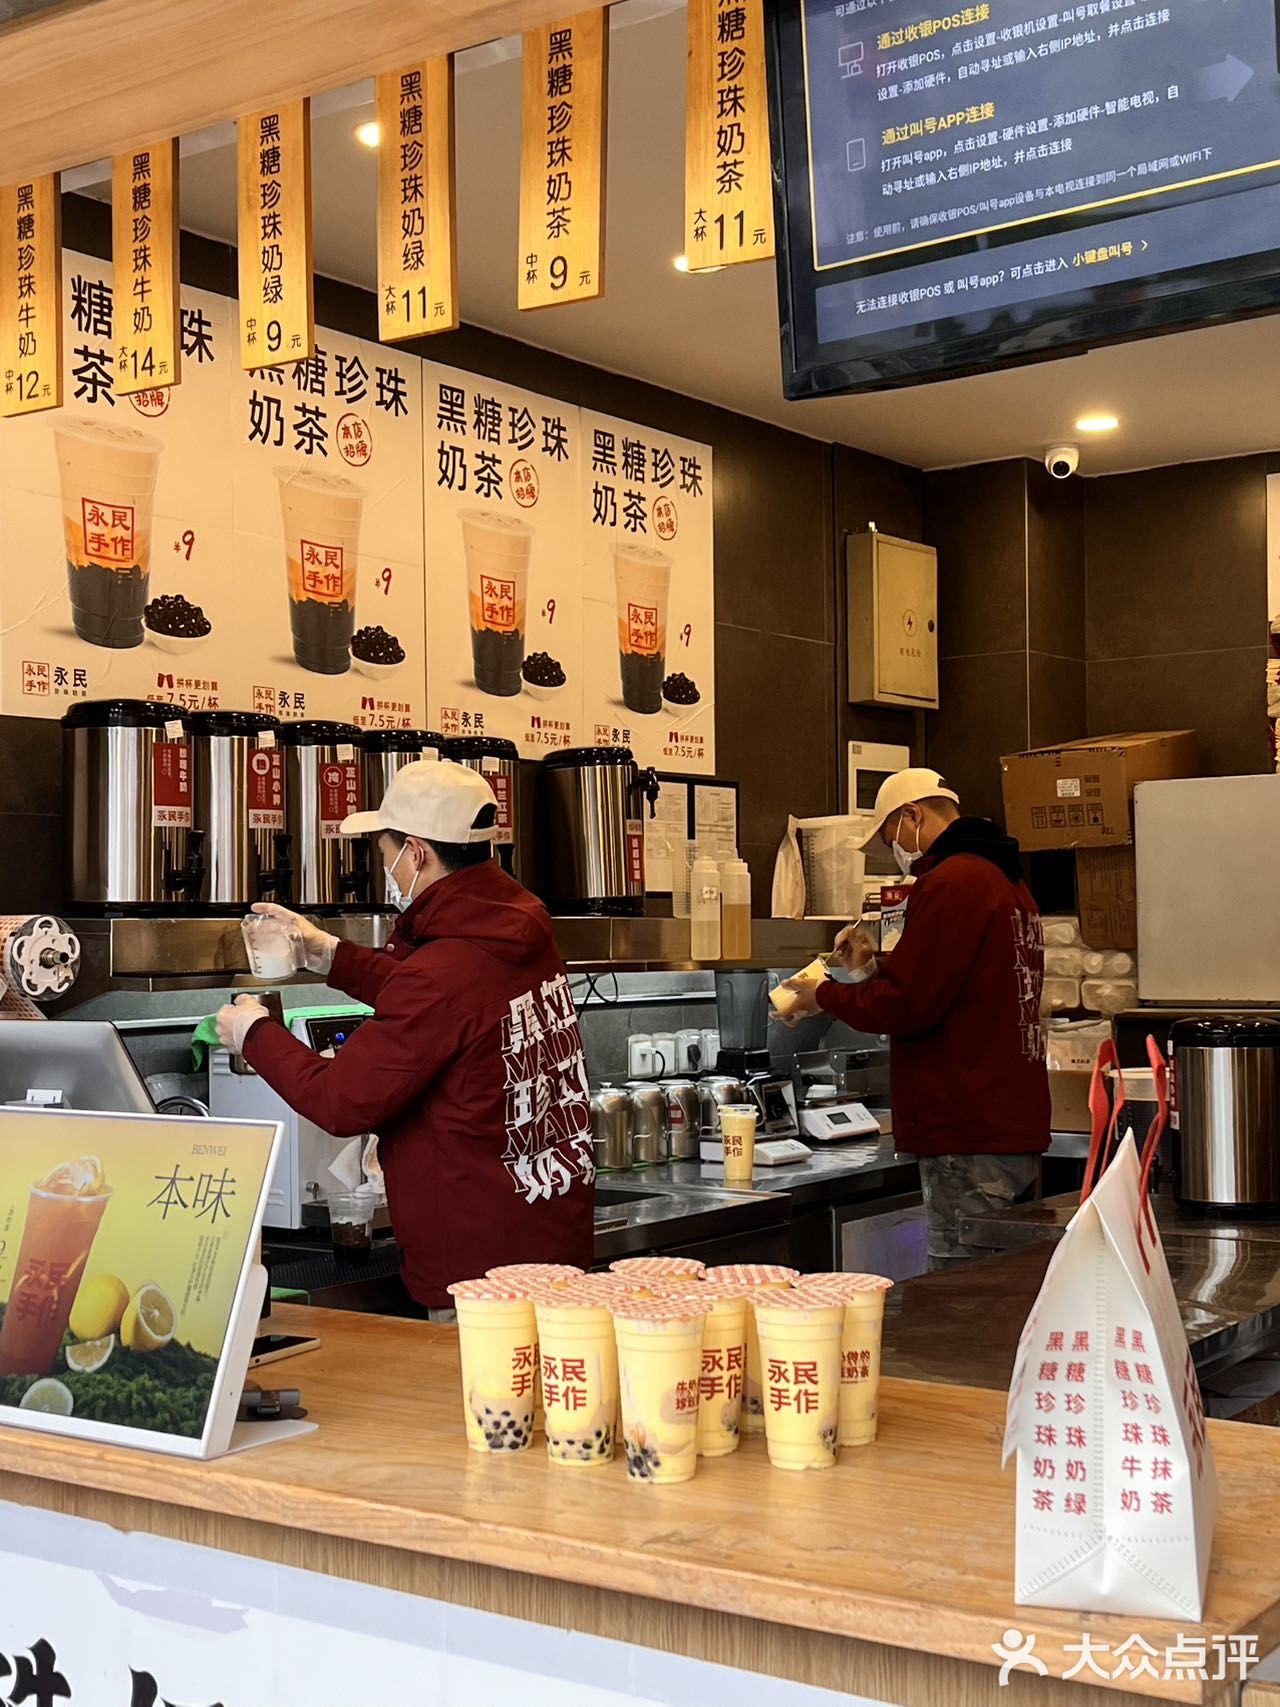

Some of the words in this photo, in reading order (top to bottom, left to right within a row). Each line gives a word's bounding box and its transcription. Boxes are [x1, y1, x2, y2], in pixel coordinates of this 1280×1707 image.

[876, 3, 990, 51] 通过收银POS连接
[544, 28, 574, 241] 黑糖珍珠奶茶
[881, 102, 995, 146] 通过叫号APP连接
[399, 70, 425, 273] 黑糖珍珠奶绿
[258, 113, 284, 305] 黑糖珍珠奶绿
[132, 152, 153, 335] 黑糖珍珠牛奶
[692, 208, 707, 242] 大杯
[713, 209, 747, 251] 11
[16, 183, 37, 359] 黑糖珍珠牛奶
[525, 252, 539, 284] 中杯
[548, 255, 569, 291] 9
[855, 284, 942, 315] 无法连接收银POS
[943, 280, 956, 294] 或
[1072, 240, 1134, 268] 小键盘叫号
[384, 284, 397, 318] 大杯
[401, 287, 430, 324] 11
[245, 316, 258, 346] 中杯
[266, 320, 282, 352] 9
[118, 346, 129, 373] 大杯
[130, 346, 156, 380] 14
[5, 368, 14, 395] 中杯
[16, 370, 40, 401] 12
[247, 390, 329, 458] 奶茶
[342, 422, 365, 440] 本店
[436, 383, 570, 463] 黑糖珍珠
[437, 440, 504, 500] 奶茶
[592, 428, 704, 498] 黑糖珍珠
[86, 504, 131, 532] 永民
[592, 481, 649, 534] 奶茶
[87, 531, 133, 562] 手作
[303, 545, 341, 570] 永民
[304, 569, 342, 593] 手作
[483, 579, 514, 601] 永民
[484, 601, 515, 624] 手作
[54, 666, 87, 688] 永民
[278, 690, 305, 710] 永民
[461, 711, 484, 728] 永民
[612, 727, 630, 744] 永民
[147, 1164, 237, 1225] 本味
[542, 1355, 587, 1383] 永民
[768, 1358, 819, 1385] 永民
[543, 1382, 588, 1411] 手作
[769, 1386, 819, 1414] 手作
[1032, 1331, 1064, 1512] 黑糖珍珠奶茶
[1064, 1330, 1090, 1516] 黑糖珍珠奶绿
[1114, 1326, 1144, 1513] 黑糖珍珠牛奶
[1131, 1329, 1174, 1515] 黑糖珍珠抹茶
